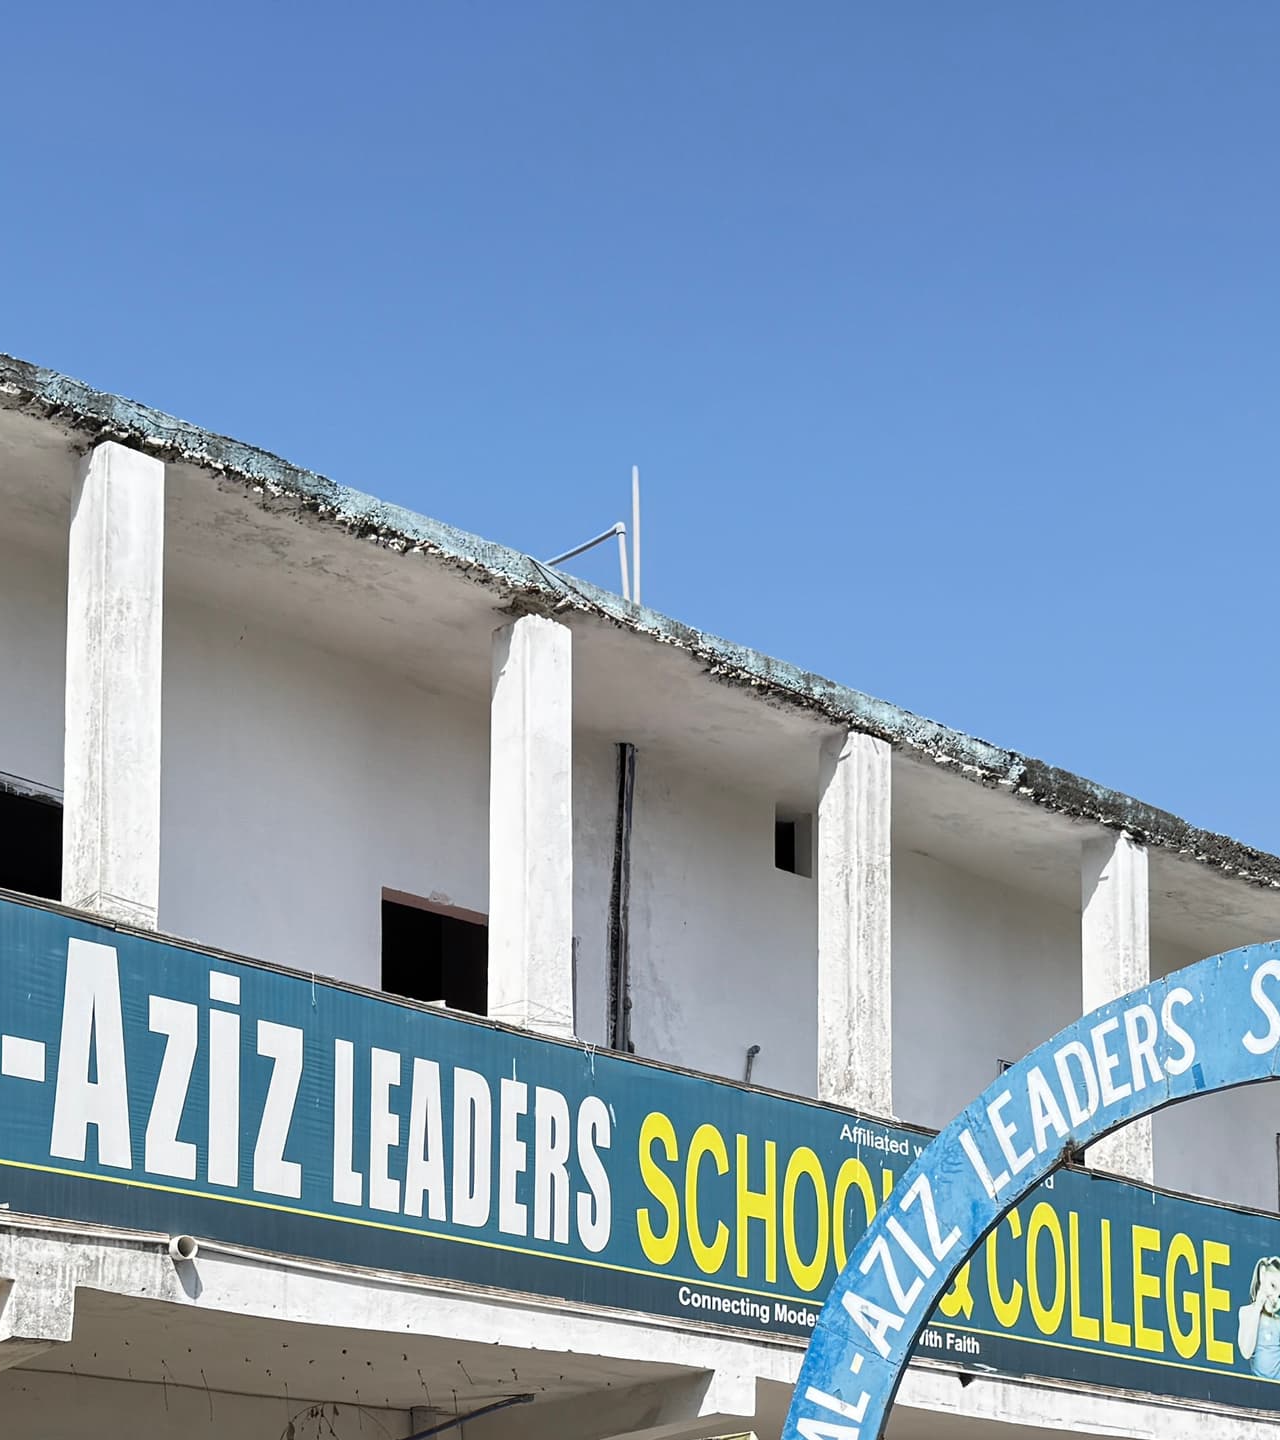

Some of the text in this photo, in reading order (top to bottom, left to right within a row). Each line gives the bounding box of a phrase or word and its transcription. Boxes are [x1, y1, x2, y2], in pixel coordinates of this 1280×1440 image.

[958, 987, 1196, 1200] LEADERS
[840, 1124, 909, 1156] Affiliated
[332, 1037, 613, 1253] LEADERS
[636, 1111, 893, 1292] SCHOO
[985, 1202, 1234, 1364] COLLEGE
[678, 1286, 820, 1327] Connecting Moder
[946, 1333, 980, 1354] Faith
